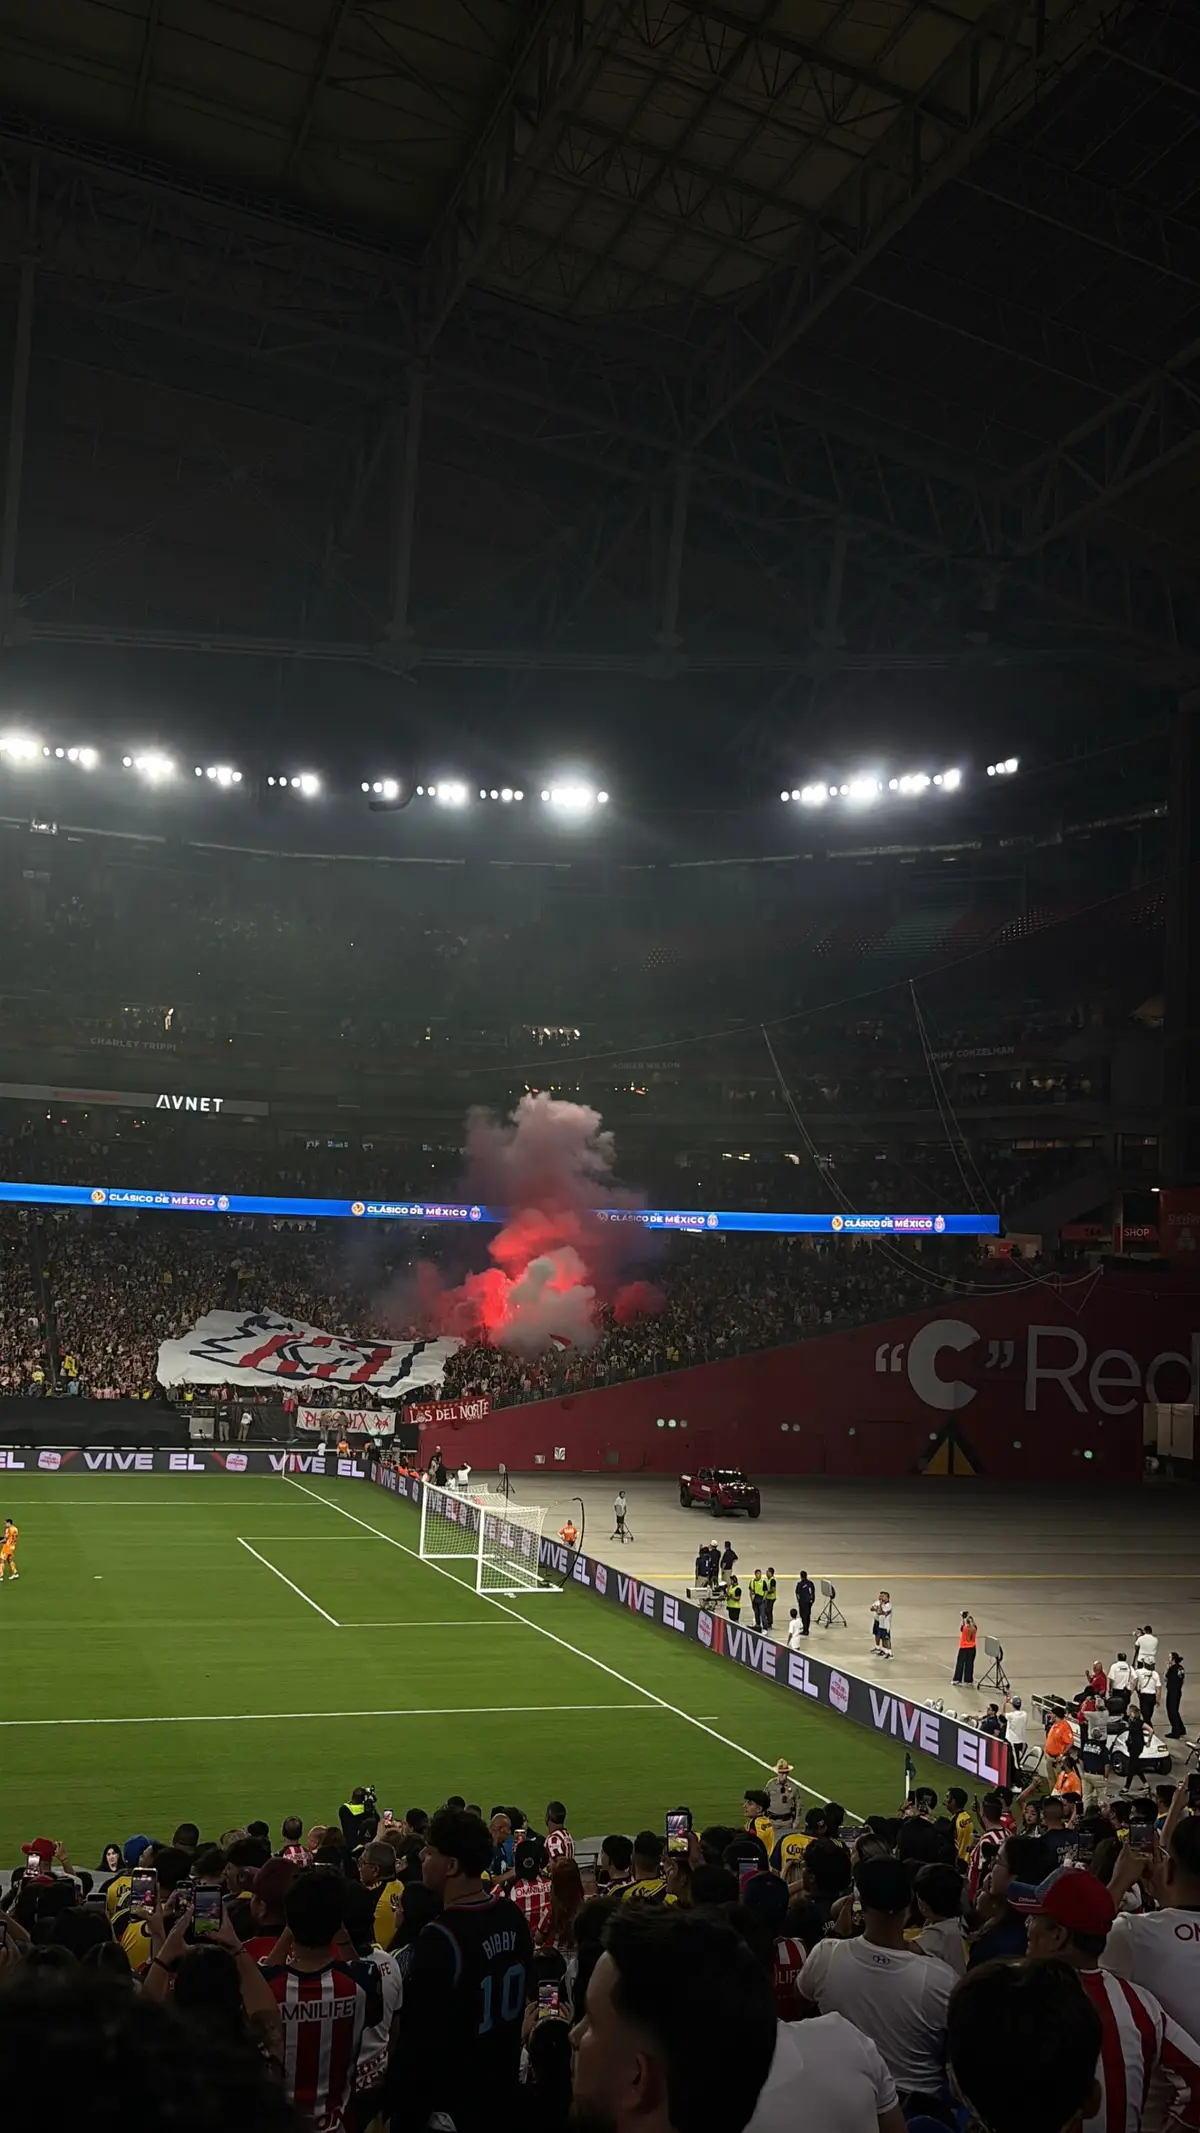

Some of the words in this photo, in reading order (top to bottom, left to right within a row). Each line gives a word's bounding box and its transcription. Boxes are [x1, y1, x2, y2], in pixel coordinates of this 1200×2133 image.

[90, 1037, 139, 1049] CHARLEY
[143, 1041, 176, 1052] TRIPPI
[156, 1094, 223, 1112] AVNET
[109, 1193, 153, 1203] CLÁSICO
[172, 1196, 215, 1206] MÉXICO
[367, 1205, 408, 1214] CLÁSICO
[410, 1207, 423, 1215] DE
[426, 1207, 468, 1216] MÉXICO
[665, 1214, 705, 1224] MÉXICO
[844, 1217, 880, 1227] CLÁSICO
[881, 1219, 893, 1227] DE
[895, 1218, 932, 1228] MÉXICO
[1123, 1228, 1150, 1237] SHOP
[436, 1407, 458, 1421] DEL
[458, 1398, 489, 1419] NORTE
[83, 1452, 154, 1470] VIVE
[169, 1453, 205, 1470] EL
[268, 1454, 326, 1474] VIVE
[336, 1459, 365, 1478] EL
[380, 1466, 397, 1490] VIVE
[398, 1475, 408, 1496] EL
[538, 1539, 568, 1574] VIVE
[572, 1554, 591, 1586] EL
[617, 1574, 655, 1617] VIVE
[662, 1595, 685, 1632] EL
[726, 1623, 777, 1677] VIVE
[788, 1652, 818, 1698] EL
[869, 1688, 940, 1756] VIVE
[957, 1728, 999, 1785] EL
[482, 1930, 517, 1960] BIBBY
[280, 1997, 354, 2022] MNILIFE
[478, 1962, 526, 2035] 10
